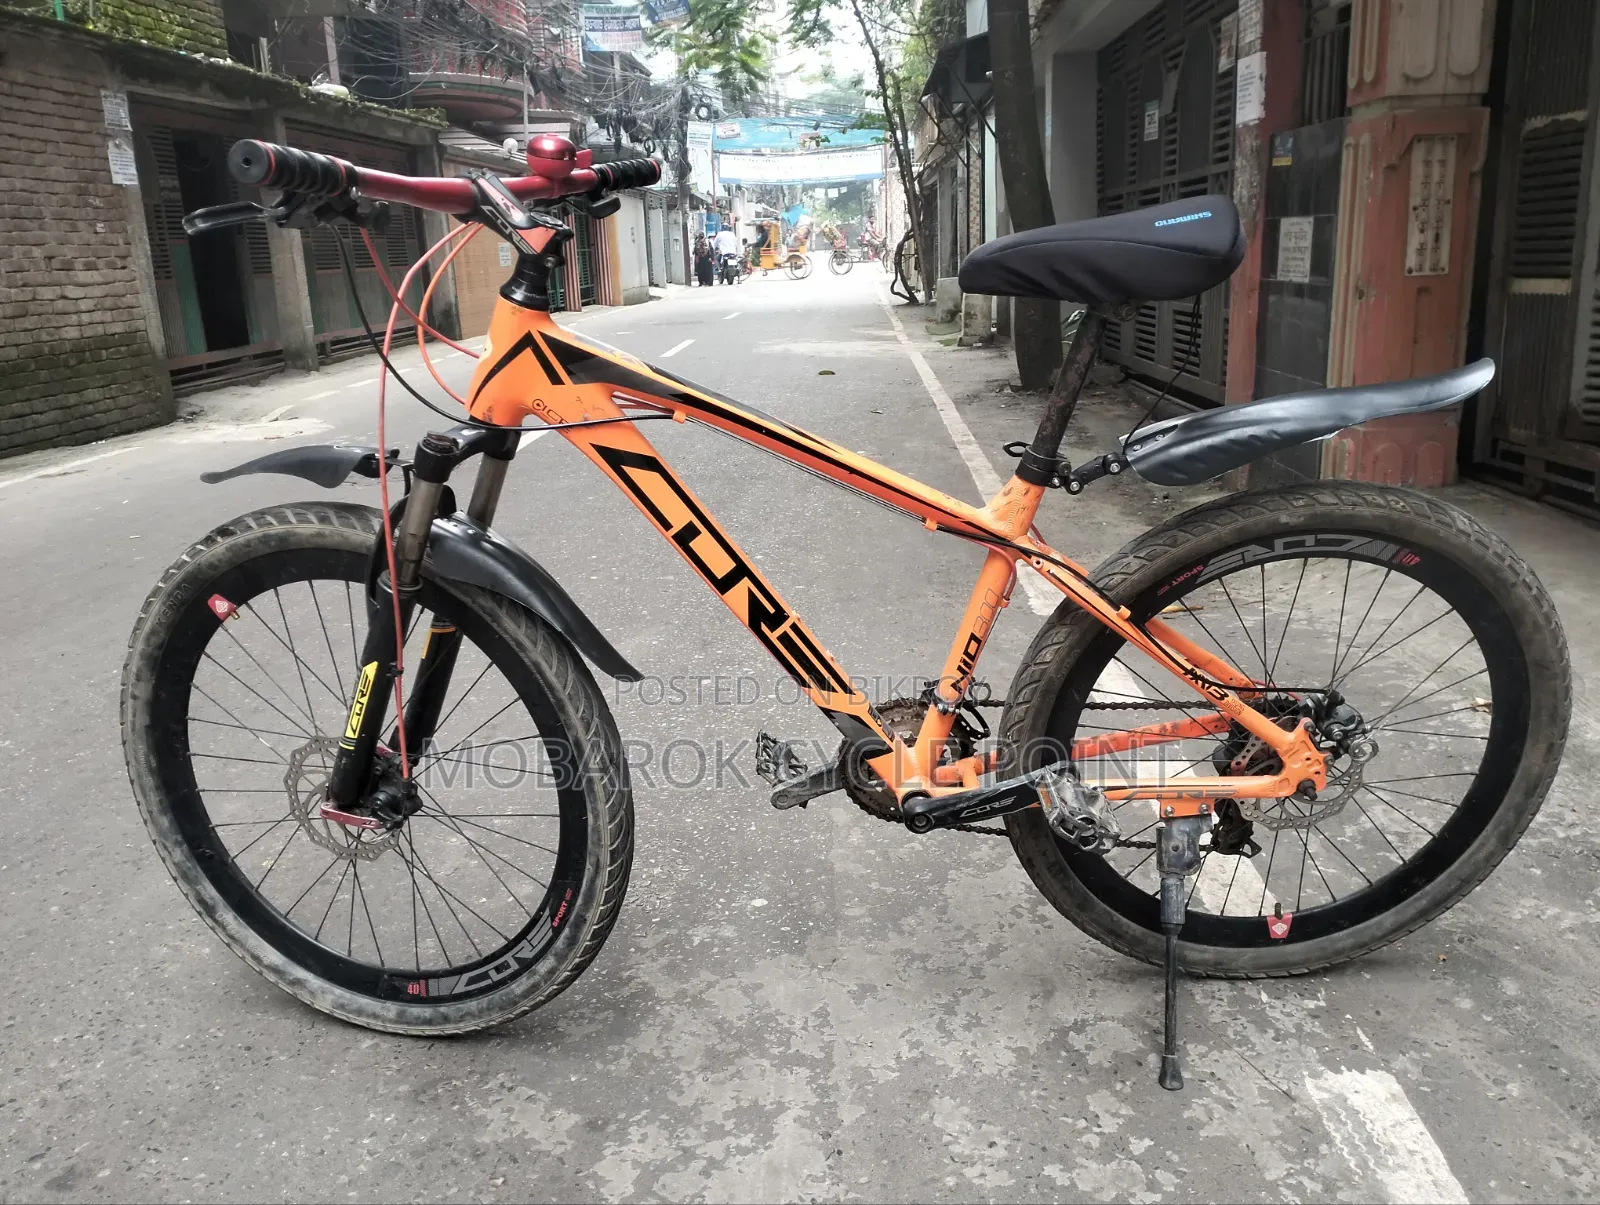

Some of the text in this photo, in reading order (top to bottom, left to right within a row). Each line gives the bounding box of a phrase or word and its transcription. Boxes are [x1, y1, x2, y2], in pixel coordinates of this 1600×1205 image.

[1154, 211, 1212, 227] SHIMANO
[589, 443, 856, 695] CORE
[1171, 564, 1205, 587] SPORT
[155, 583, 192, 626] KENDA
[960, 795, 1017, 818] CORE
[552, 900, 568, 927] SPORT
[407, 983, 420, 995] 40
